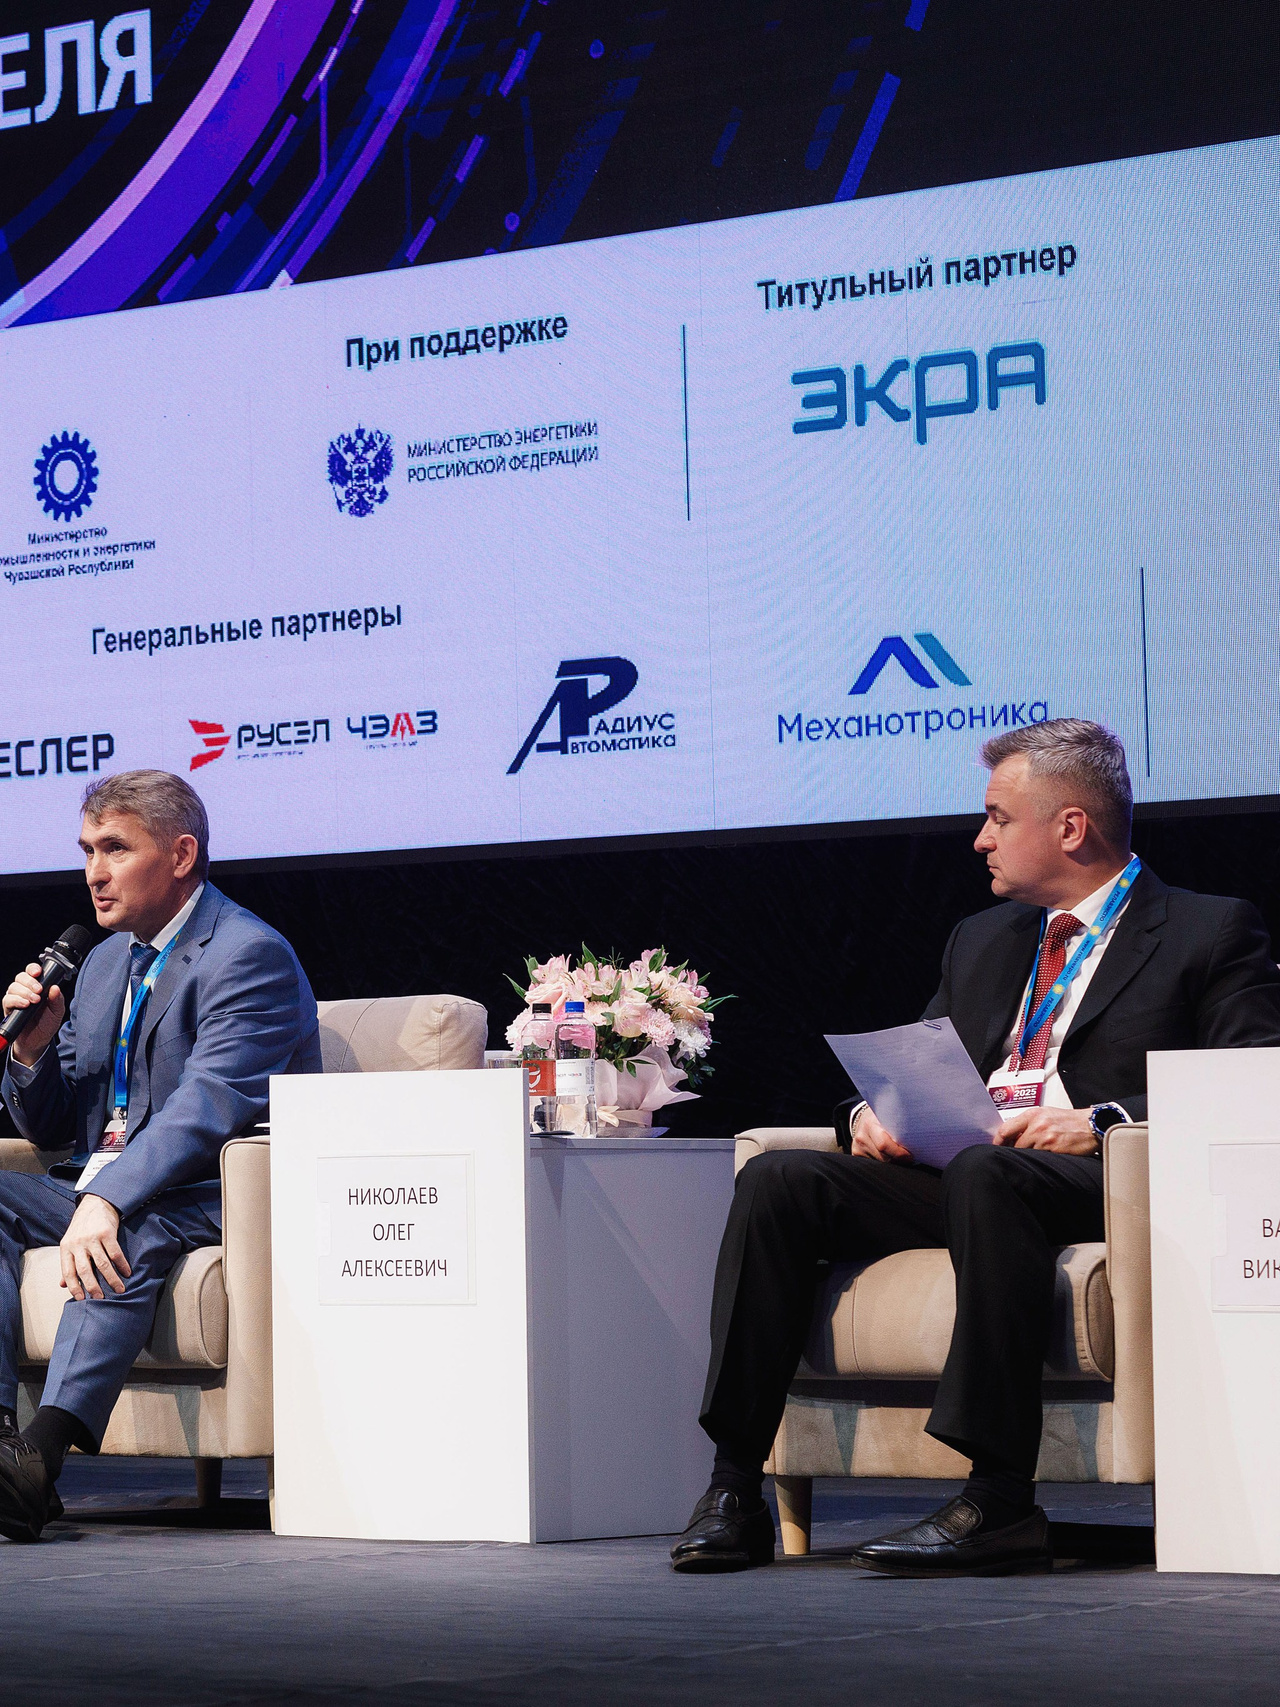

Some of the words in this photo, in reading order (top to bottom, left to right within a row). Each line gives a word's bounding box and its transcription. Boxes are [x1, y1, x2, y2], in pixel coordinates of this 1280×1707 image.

[756, 256, 934, 311] Титульный
[945, 243, 1077, 287] партнер
[345, 336, 401, 371] При
[409, 314, 569, 358] поддержке
[790, 340, 1047, 445] ЭКРА
[407, 431, 513, 459] МИНИСТЕРСТВО
[515, 420, 599, 446] ЭНЕРГЕТИКИ
[407, 455, 507, 483] РОССИЙСКОЙ
[508, 445, 600, 472] ФЕДЕРАЦИИ
[27, 526, 108, 545] Министерство
[83, 547, 91, 557] и
[93, 540, 156, 556] энергетики
[4, 565, 65, 585] Чувашской
[68, 558, 135, 577] Республики
[91, 617, 262, 656] Генеральные
[271, 604, 402, 642] партнеры
[777, 700, 1049, 744] Механотроника
[1013, 1088, 1037, 1098] 2025
[348, 1186, 440, 1206] НИКОЛАЕВ
[372, 1223, 416, 1241] ОЛЕГ
[341, 1258, 448, 1277] АЛЕКСЕЕВИЧ
